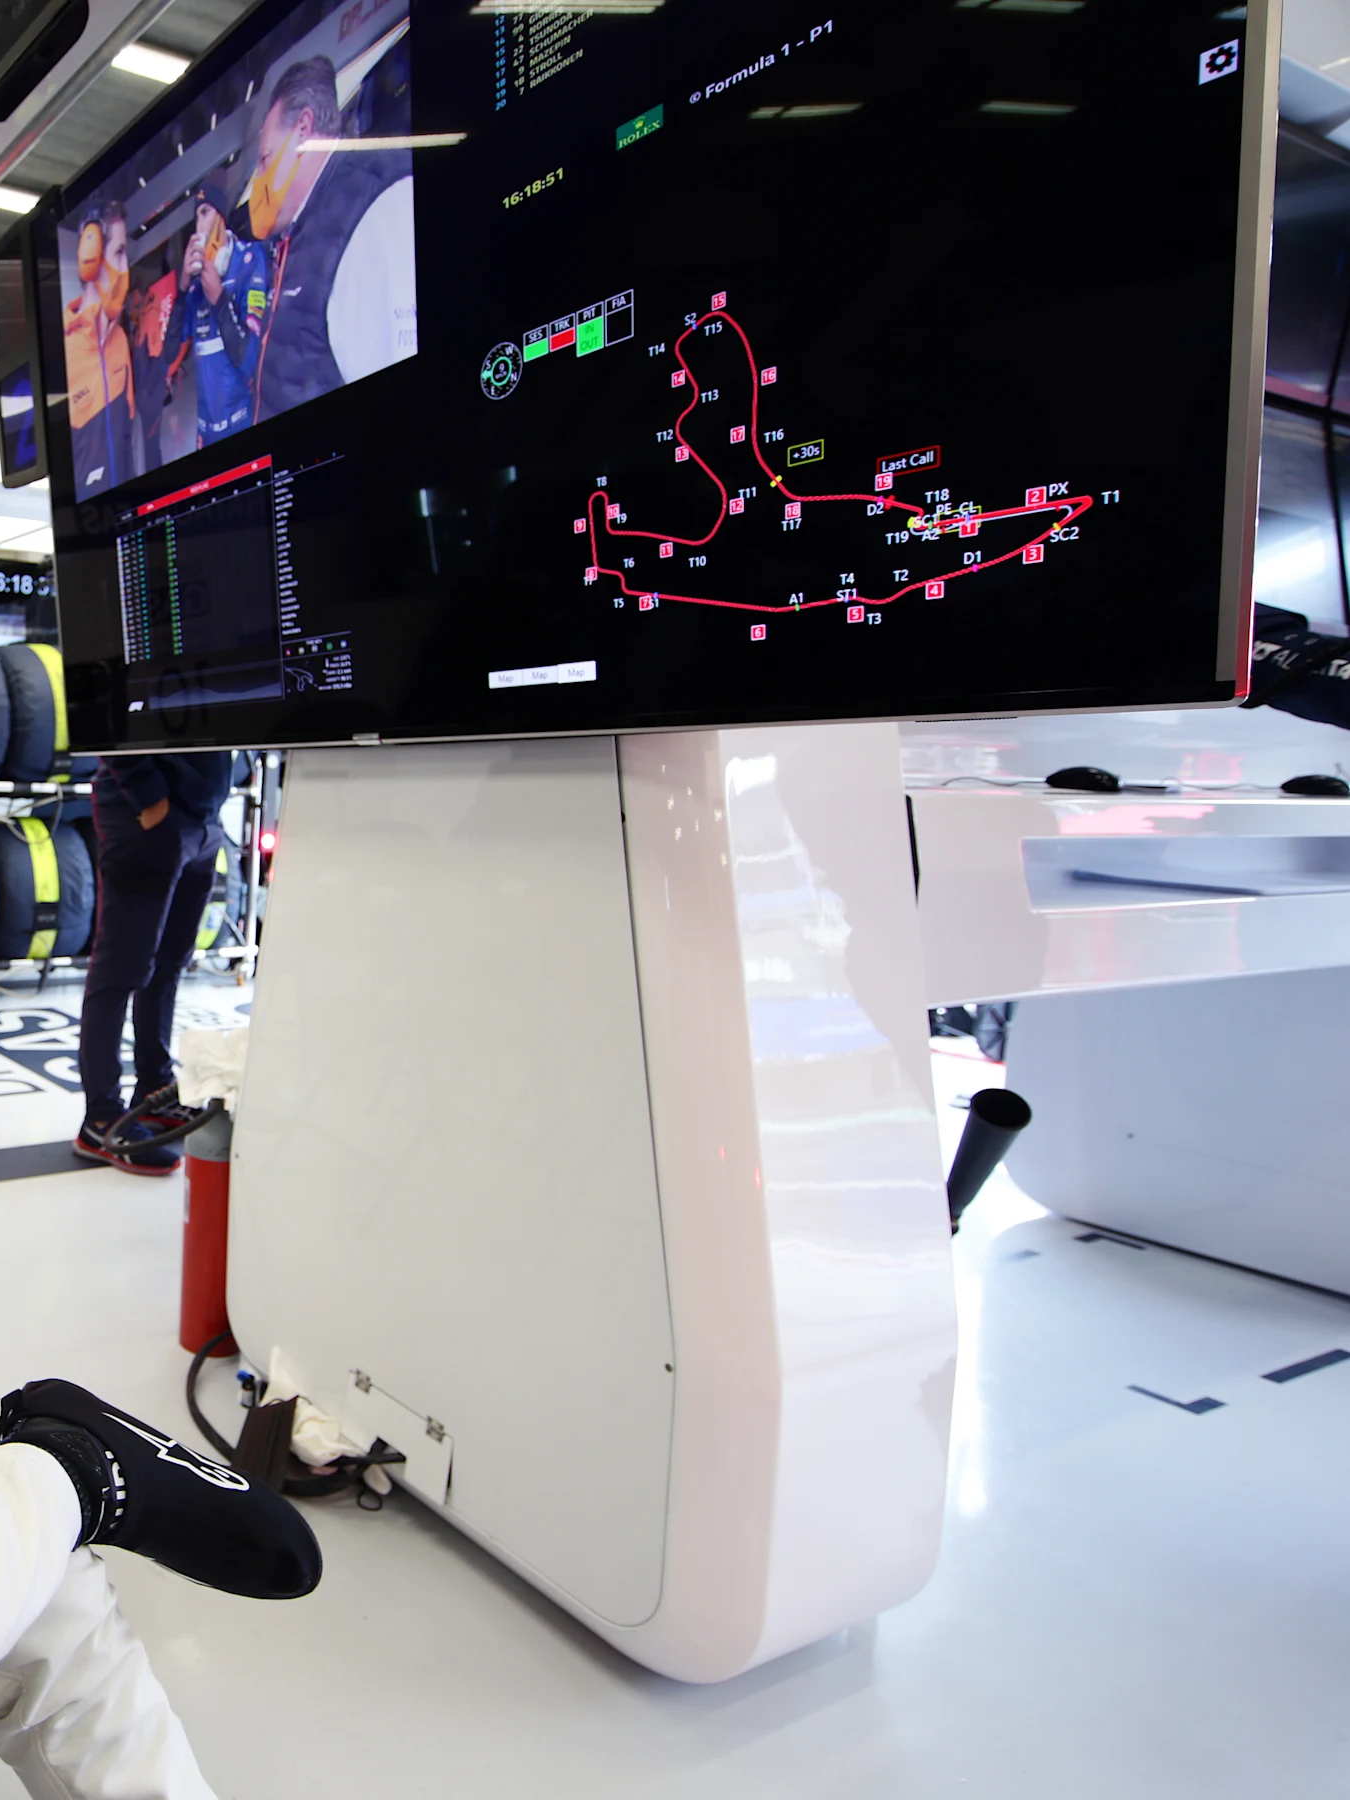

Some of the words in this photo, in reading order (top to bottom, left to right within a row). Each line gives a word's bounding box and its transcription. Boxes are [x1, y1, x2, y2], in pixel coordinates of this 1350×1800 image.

[513, 44, 524, 57] 22
[529, 11, 573, 46] TSUNODA
[496, 66, 506, 78] 17
[513, 55, 524, 67] 47
[529, 8, 594, 57] SCHUMACHER
[495, 46, 505, 58] 15
[705, 54, 775, 99] Formula
[781, 43, 790, 56] 1
[810, 19, 833, 43] P1
[496, 78, 506, 89] 18
[530, 34, 571, 67] MAZEPIN
[496, 88, 506, 99] 19
[530, 52, 563, 78] STROLL
[496, 99, 506, 111] 20
[530, 48, 584, 89] RAIKKONEN
[618, 119, 661, 149] ROLEX
[502, 167, 564, 209] 16:18:51
[612, 296, 626, 309] FIA
[713, 294, 726, 307] 15
[583, 307, 597, 321] PIT
[684, 313, 697, 326] S2
[554, 318, 570, 333] TRK
[584, 324, 595, 335] IN
[704, 321, 723, 336] T15
[528, 329, 543, 344] SES
[579, 336, 600, 351] OUT
[648, 343, 666, 357] T14
[673, 373, 685, 384] 14
[762, 369, 775, 382] 16
[700, 389, 719, 404] T13
[656, 429, 674, 443] T12
[732, 429, 744, 441] 17
[764, 428, 785, 443] T16
[677, 448, 688, 460] 13
[793, 444, 820, 459] +30s
[881, 457, 908, 473] Last
[910, 450, 935, 466] Call
[596, 476, 607, 488] T8
[877, 475, 891, 487] 19
[738, 487, 757, 499] T11
[924, 488, 950, 503] T18
[1049, 482, 1069, 497] PX
[1101, 490, 1120, 505] T1
[609, 506, 619, 517] 10
[731, 501, 743, 512] 12
[787, 505, 799, 517] 18
[867, 502, 884, 516] D2
[936, 503, 952, 516] PE
[781, 518, 802, 531] T17
[885, 530, 909, 545] T19
[1050, 526, 1080, 543] SC2
[661, 545, 672, 556] 11
[964, 550, 981, 565] D1
[623, 557, 635, 569] T6
[688, 556, 707, 568] T10
[839, 573, 855, 585] T4
[893, 569, 909, 582] T2
[789, 592, 804, 605] A1
[836, 588, 857, 602] ST1
[613, 598, 624, 608] T5
[867, 613, 882, 625] T3
[498, 675, 514, 685] Map
[532, 671, 548, 681] Map
[567, 667, 585, 679] Map
